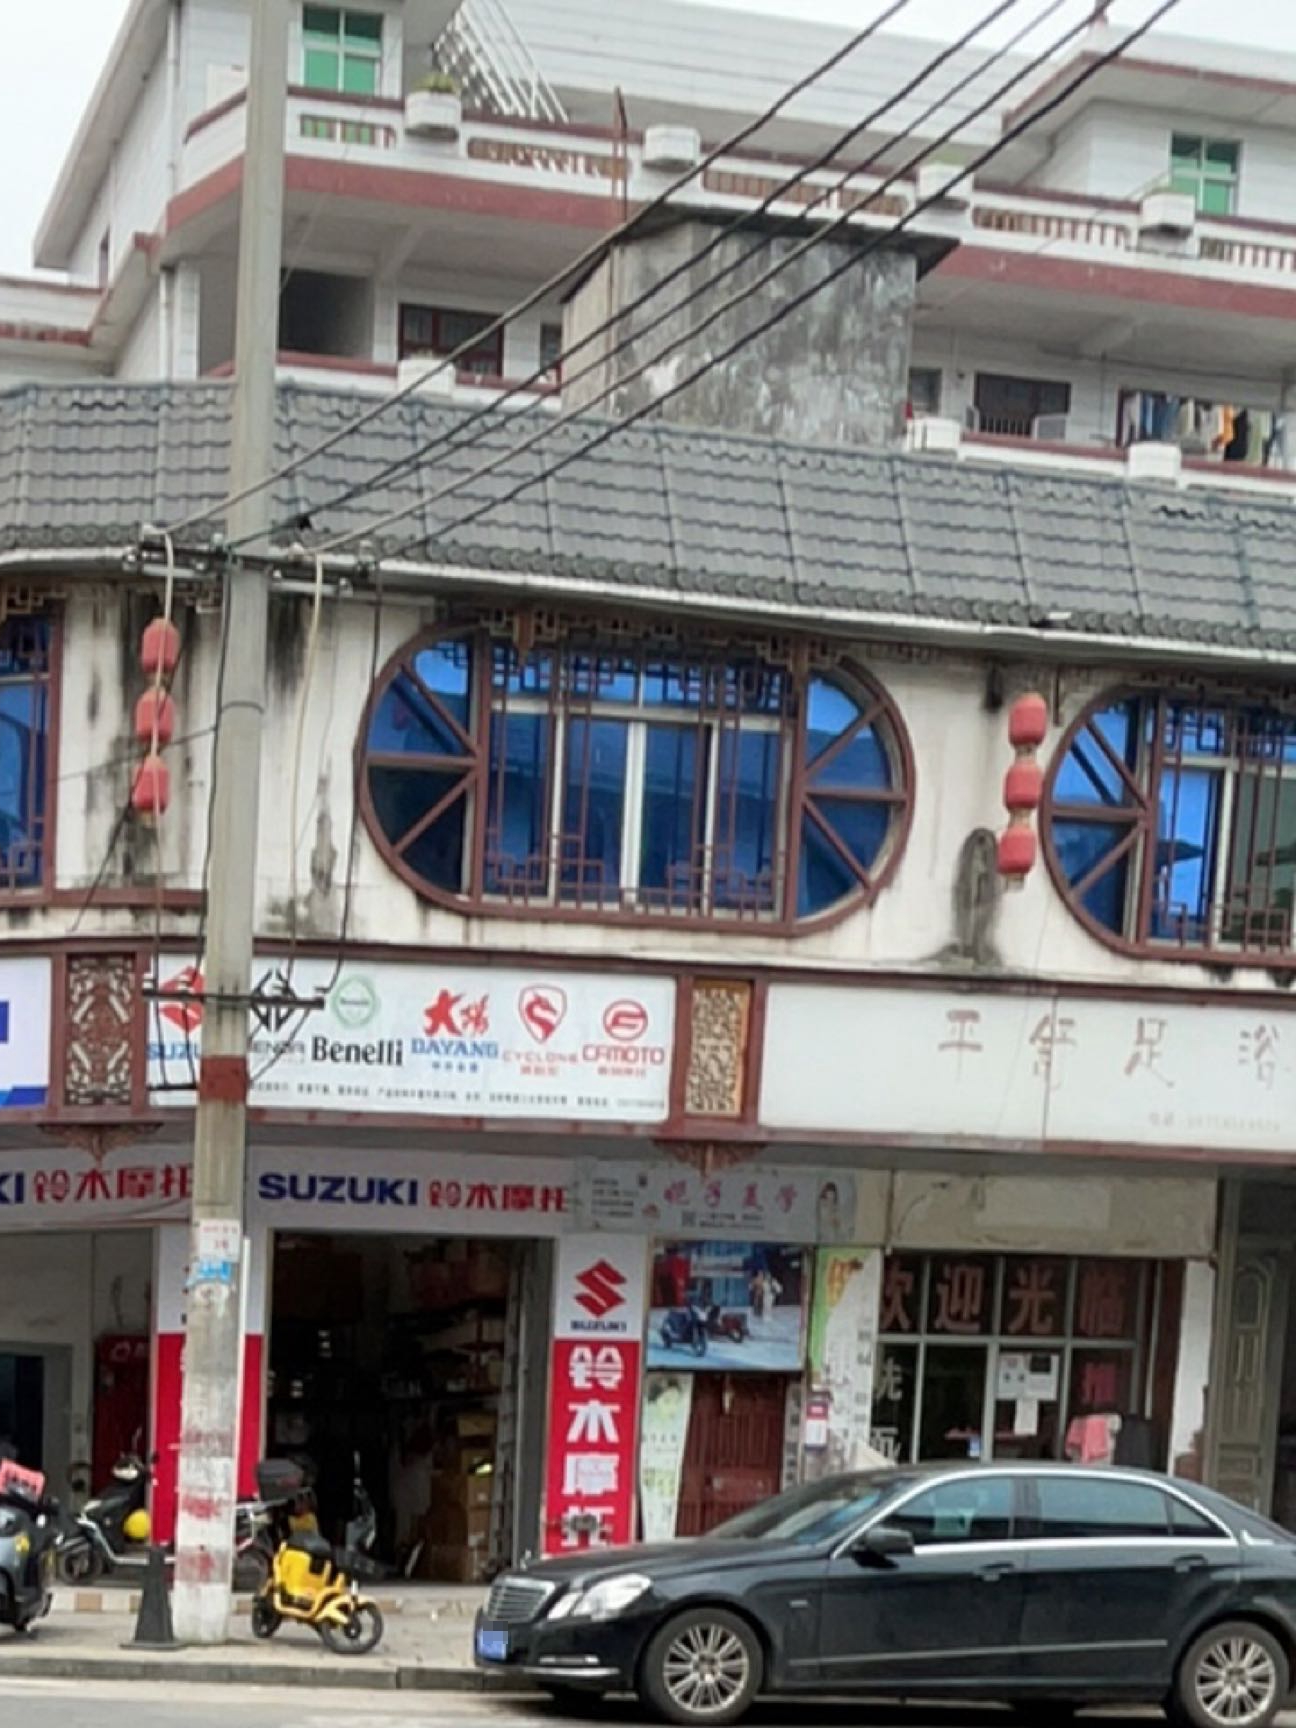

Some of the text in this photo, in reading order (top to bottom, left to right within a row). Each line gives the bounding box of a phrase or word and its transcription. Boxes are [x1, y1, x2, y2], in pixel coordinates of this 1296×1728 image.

[311, 1035, 403, 1067] Benelli
[411, 1038, 499, 1060] DAYANG
[503, 1049, 578, 1063] CYCLONE
[34, 1163, 193, 1204] 铃木摩托
[257, 1171, 418, 1206] SUZUKI
[428, 1178, 568, 1213] 铃木摩托
[570, 1320, 627, 1332] SUZUKI
[561, 1345, 624, 1547] 铃木摩托
